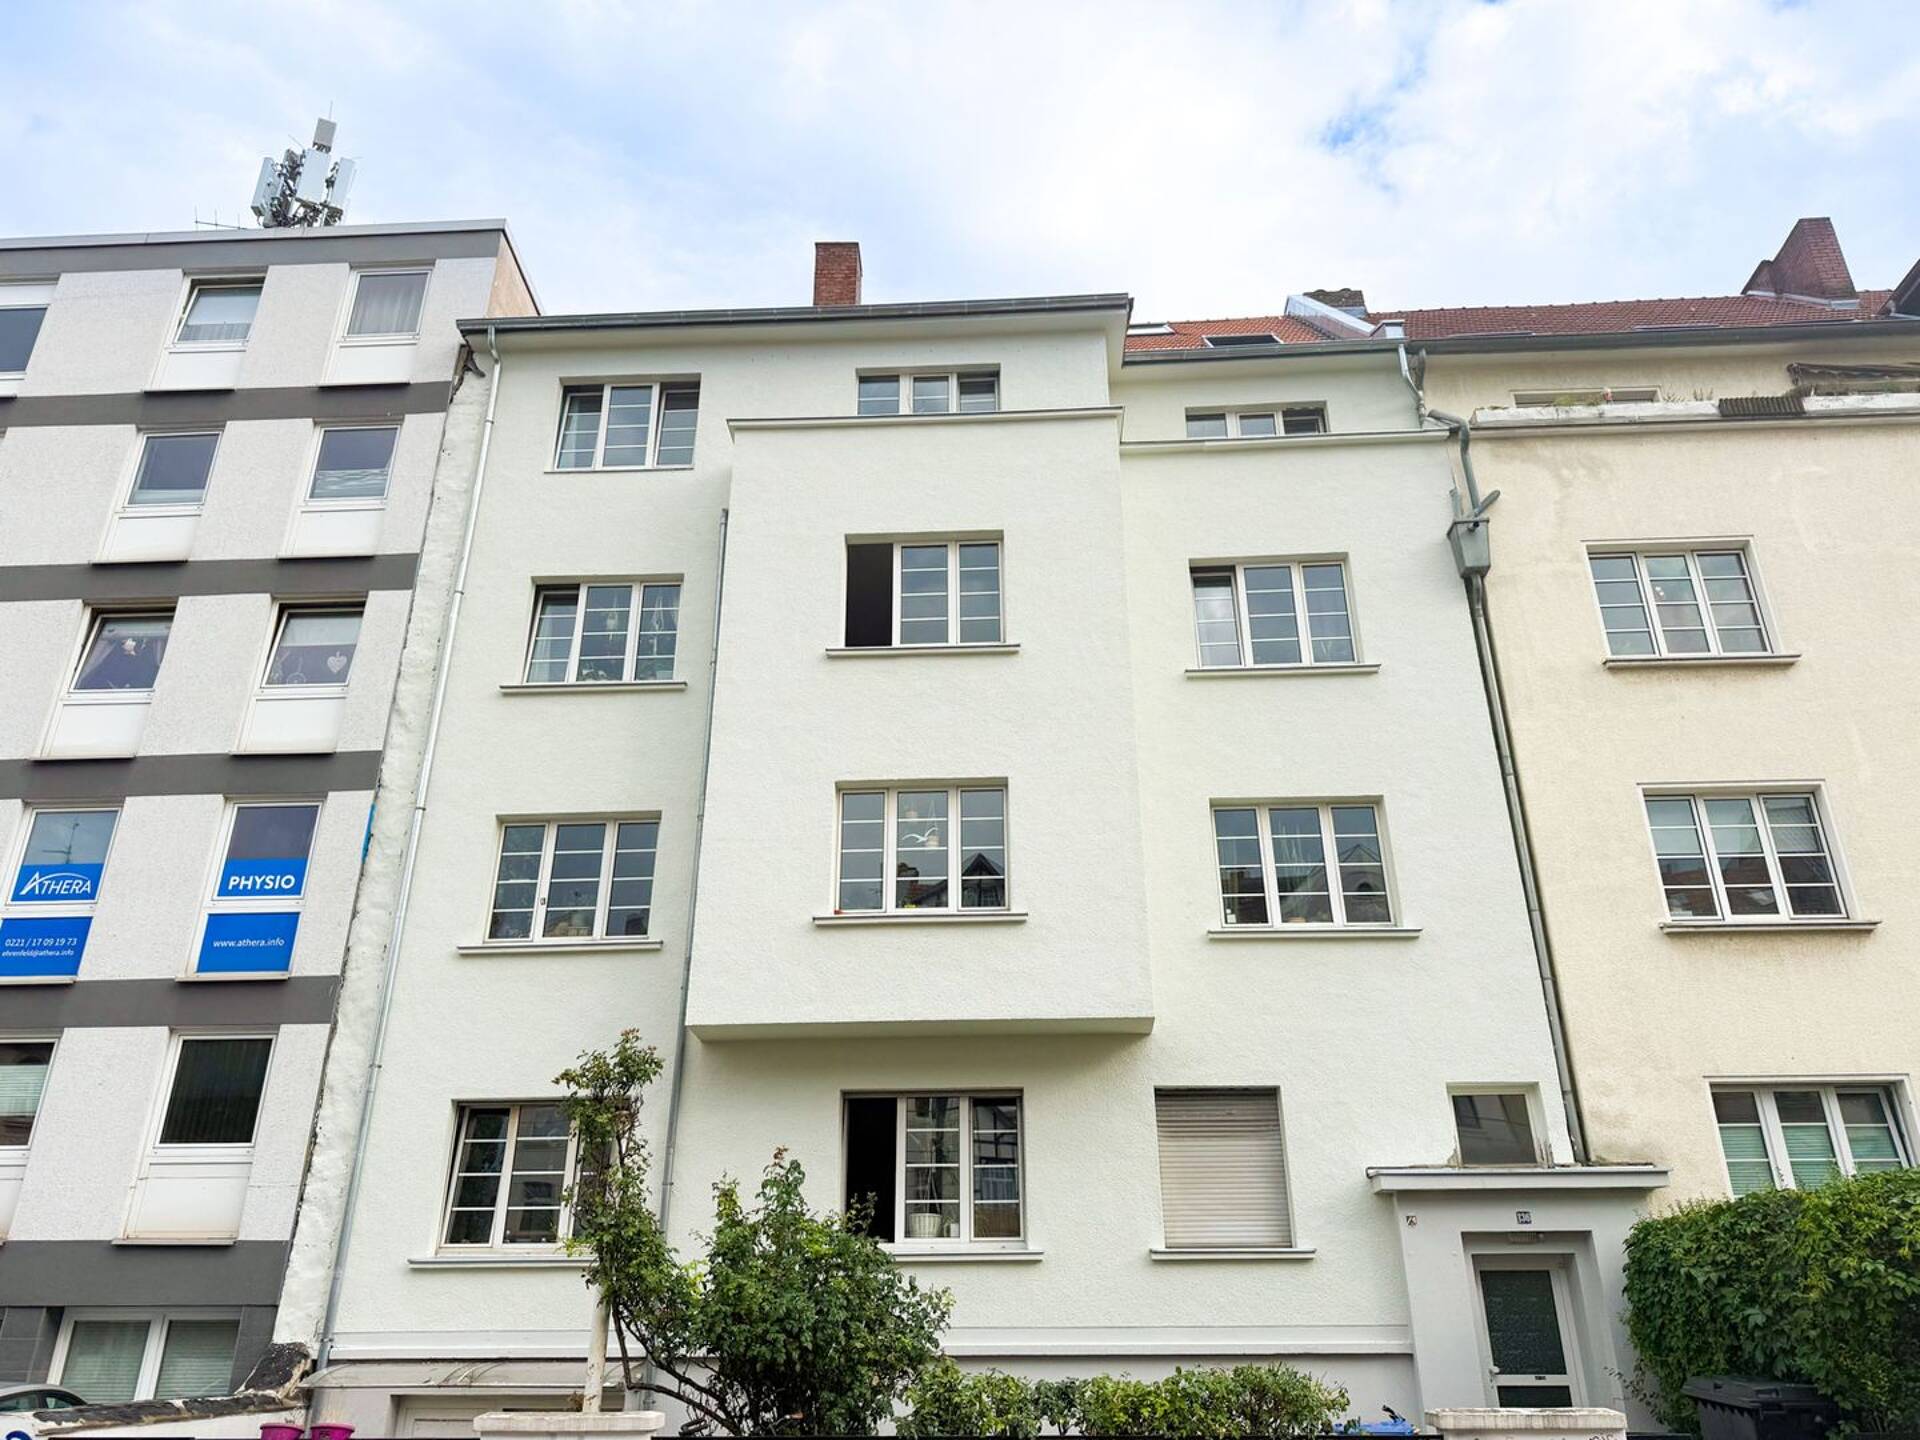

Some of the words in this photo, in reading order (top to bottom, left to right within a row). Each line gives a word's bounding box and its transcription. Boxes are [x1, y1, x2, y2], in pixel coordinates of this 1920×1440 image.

[228, 874, 295, 890] PHYSIO
[4, 938, 25, 946] 0221
[32, 938, 42, 946] 17
[43, 938, 54, 946] 09
[55, 938, 65, 946] 19
[67, 938, 78, 946] 73
[213, 937, 285, 948] www.athera.info
